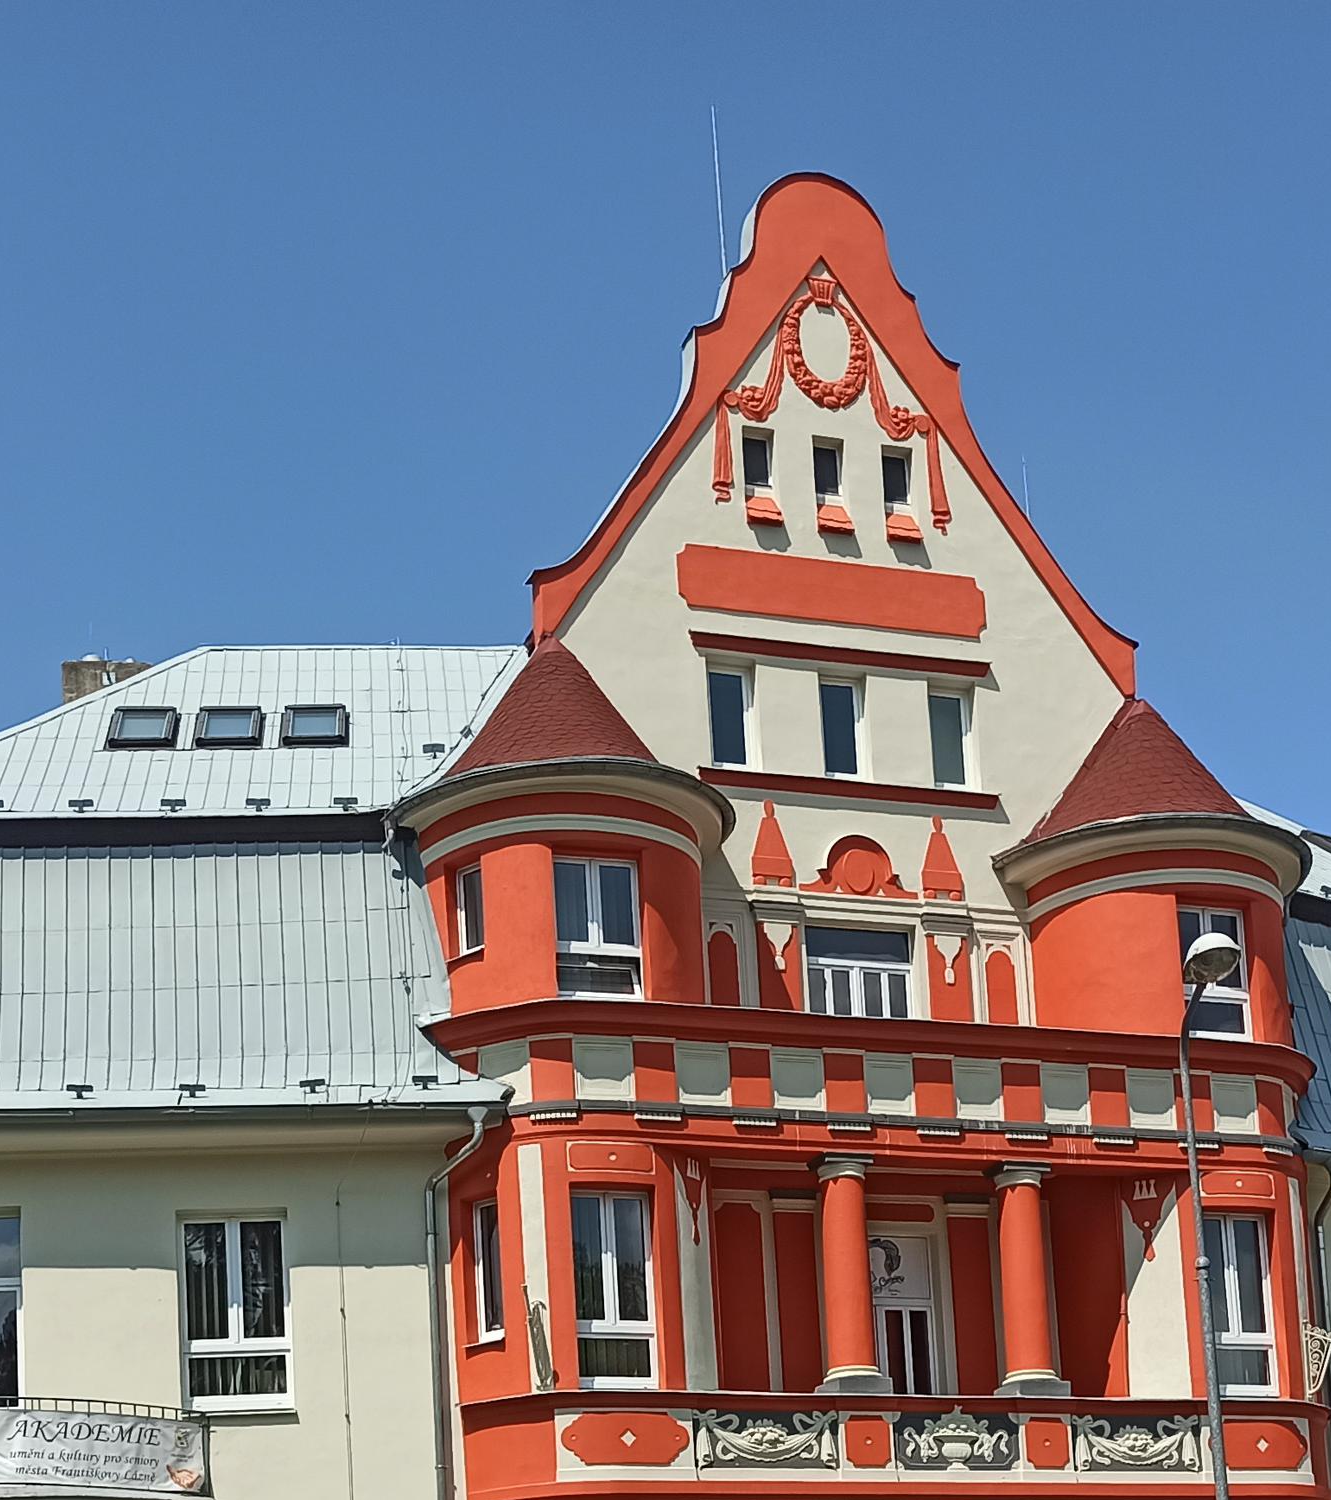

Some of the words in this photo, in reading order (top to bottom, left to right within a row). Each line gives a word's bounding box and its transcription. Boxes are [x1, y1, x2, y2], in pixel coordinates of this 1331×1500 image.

[7, 1419, 161, 1446] AKADEMIE
[9, 1449, 45, 1460] umění
[48, 1452, 55, 1460] a
[59, 1449, 101, 1465] kultury
[103, 1455, 121, 1467] pro
[124, 1456, 160, 1468] seniory
[15, 1465, 48, 1476] města
[52, 1465, 120, 1482] Františkovy
[124, 1469, 156, 1482] Lázně
